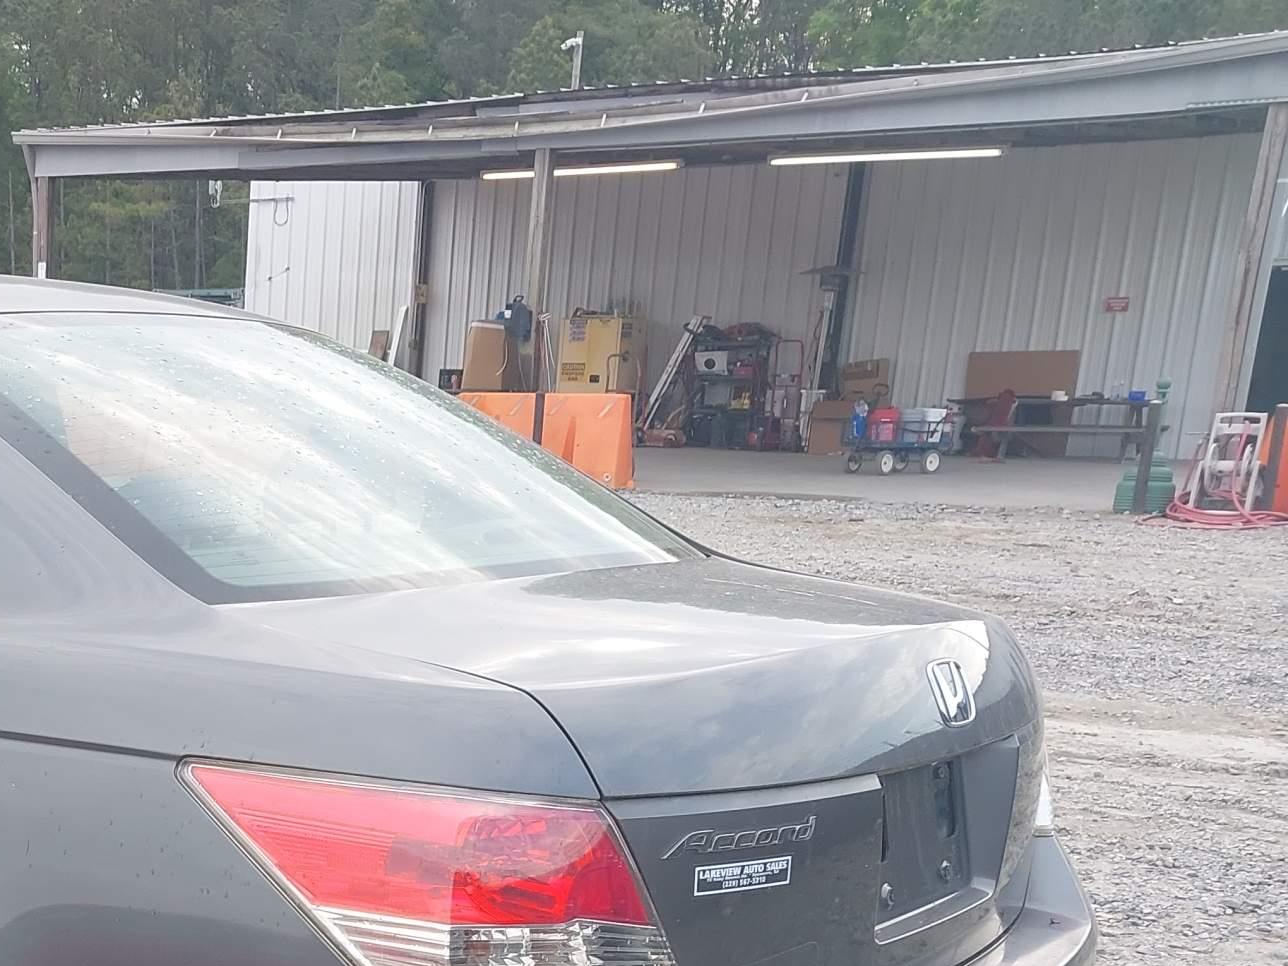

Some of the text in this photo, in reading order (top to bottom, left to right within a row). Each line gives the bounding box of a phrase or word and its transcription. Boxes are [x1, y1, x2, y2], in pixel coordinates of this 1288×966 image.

[661, 815, 817, 860] Accord
[699, 866, 742, 880] LAKEVIEW
[743, 863, 765, 875] AUTO
[766, 860, 788, 872] SALES
